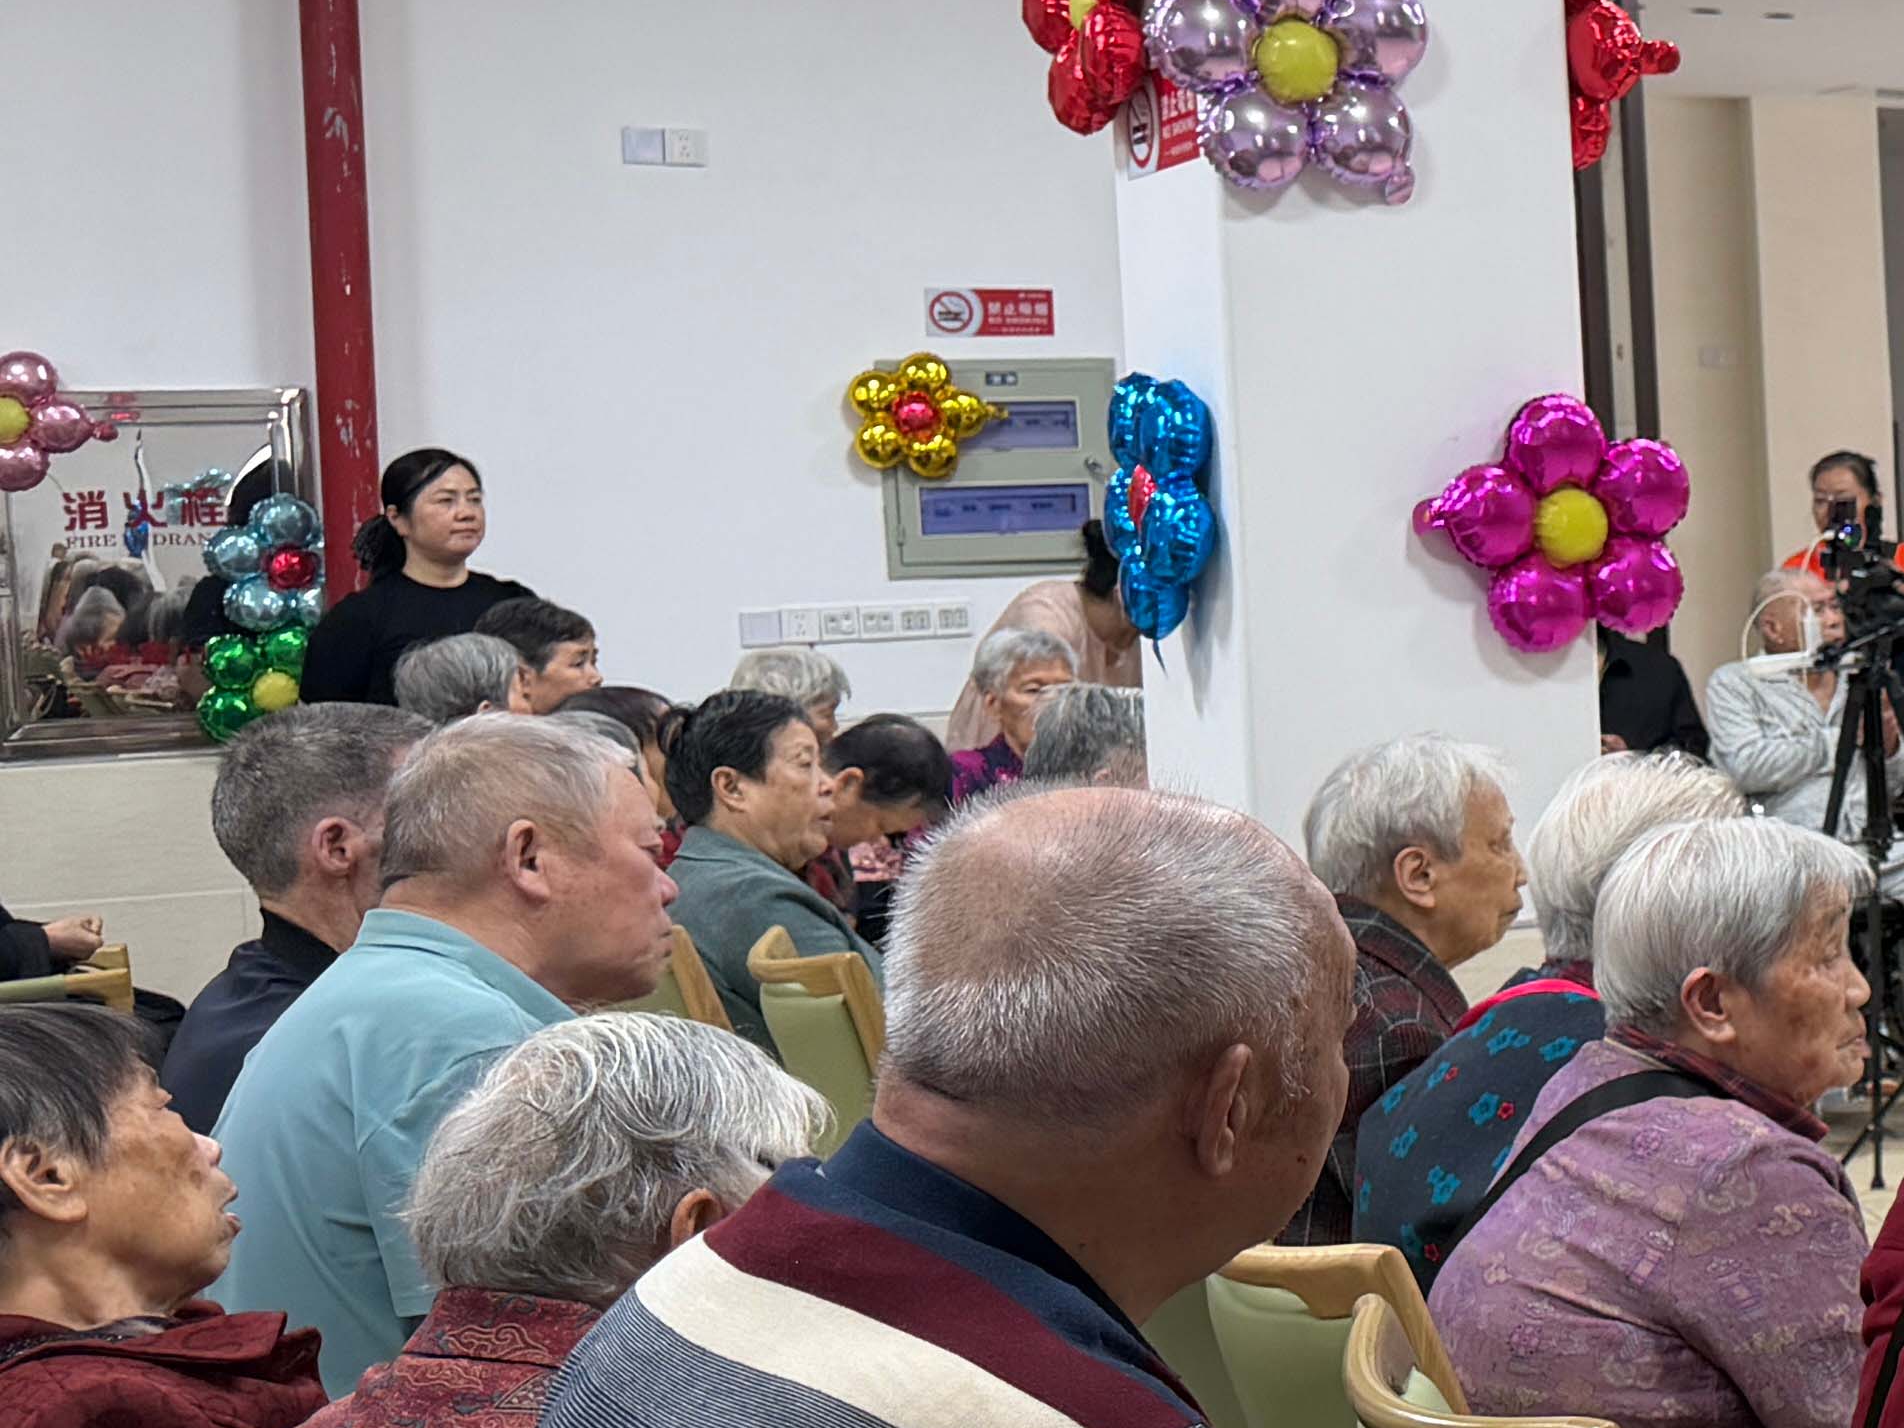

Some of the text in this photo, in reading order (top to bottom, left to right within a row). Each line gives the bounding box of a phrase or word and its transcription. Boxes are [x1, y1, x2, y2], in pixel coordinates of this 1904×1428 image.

[63, 489, 227, 532] 消火栓
[65, 533, 117, 549] FIRE
